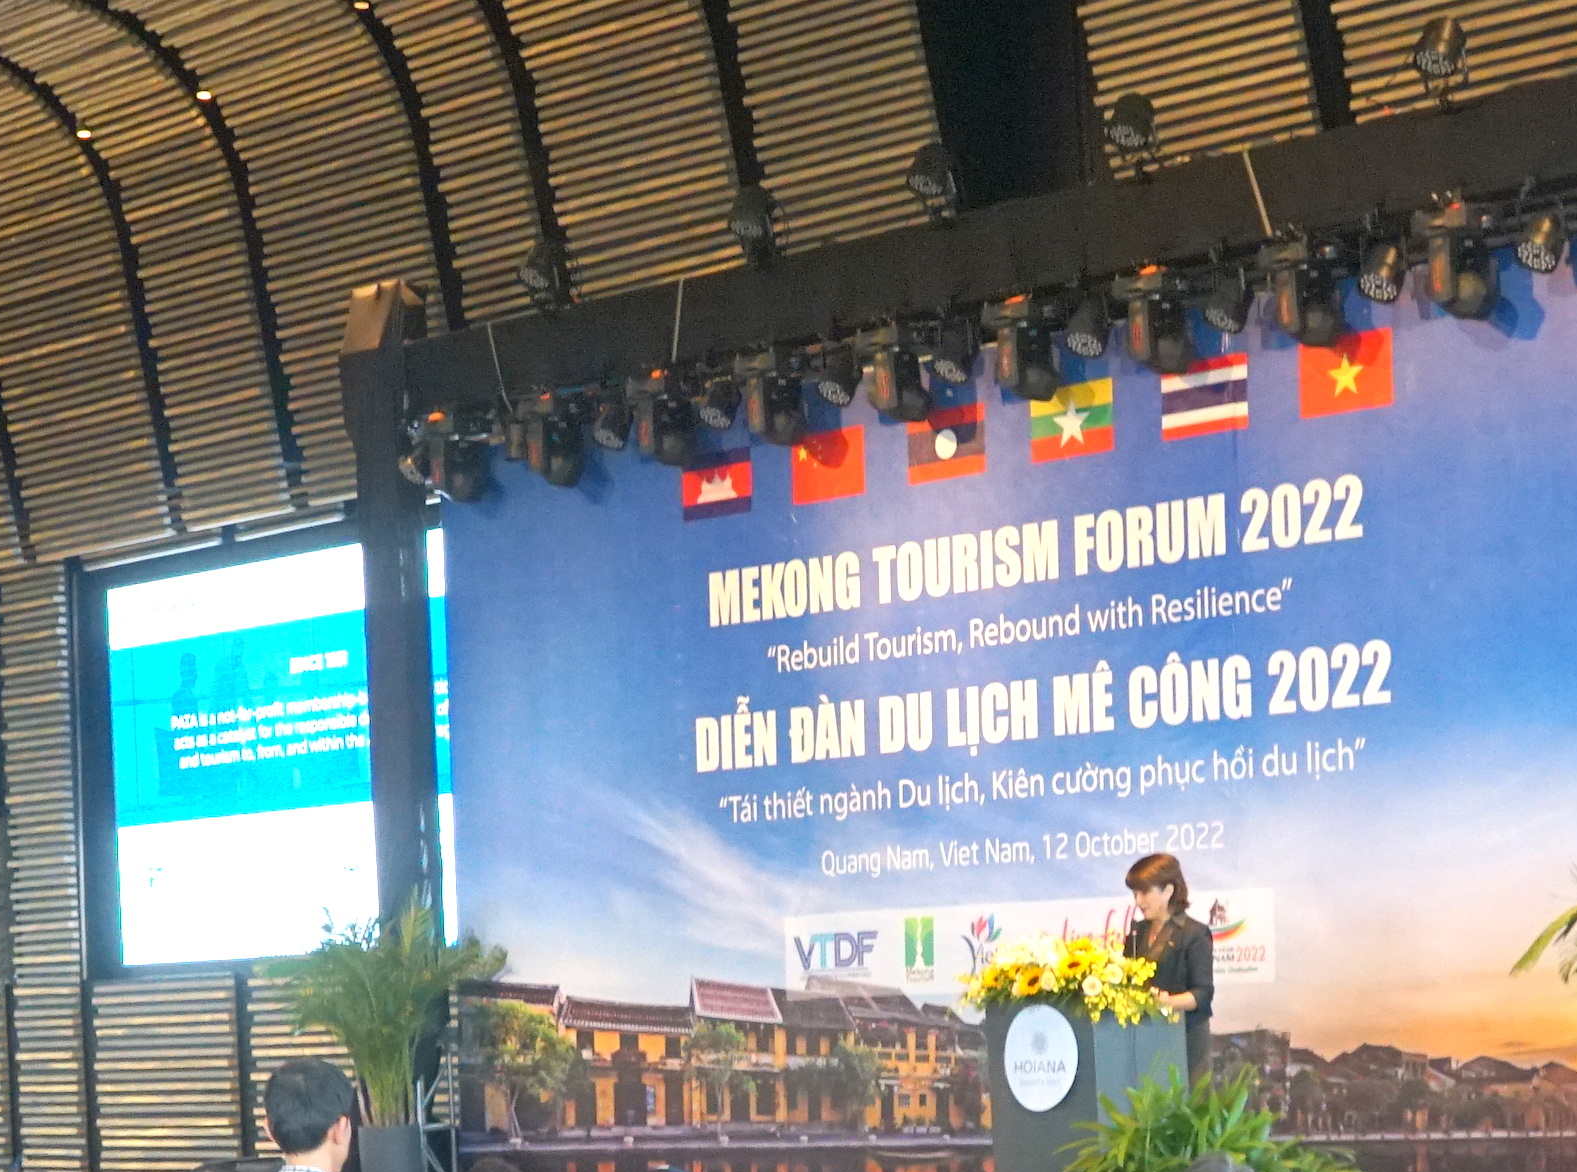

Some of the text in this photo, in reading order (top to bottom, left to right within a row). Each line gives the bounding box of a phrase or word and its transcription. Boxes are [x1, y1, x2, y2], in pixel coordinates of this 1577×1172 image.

[709, 473, 1364, 628] MEKONG TOURISM FORUM 2022
[767, 577, 1293, 673] “Rebuild Tourism, Rebound with Resilience”
[286, 690, 368, 715] membership-b
[695, 639, 1392, 773] DIỄN ĐÀN DU LỊCH MÊ CÔNG 2022
[274, 721, 293, 737] the
[295, 713, 357, 734] responsible
[179, 752, 199, 769] and
[286, 739, 307, 756] and
[309, 734, 344, 753] within
[345, 733, 364, 749] the
[719, 737, 1366, 823] “Tái thiết ngành Du lịch, Kiên cường phục hồi du lịch”
[821, 820, 1225, 878] Quang Nam, Viet Nam, 12 October 2022
[793, 930, 878, 971] VTDF
[1237, 945, 1266, 962] 2022
[1014, 1060, 1066, 1074] HOIANA
